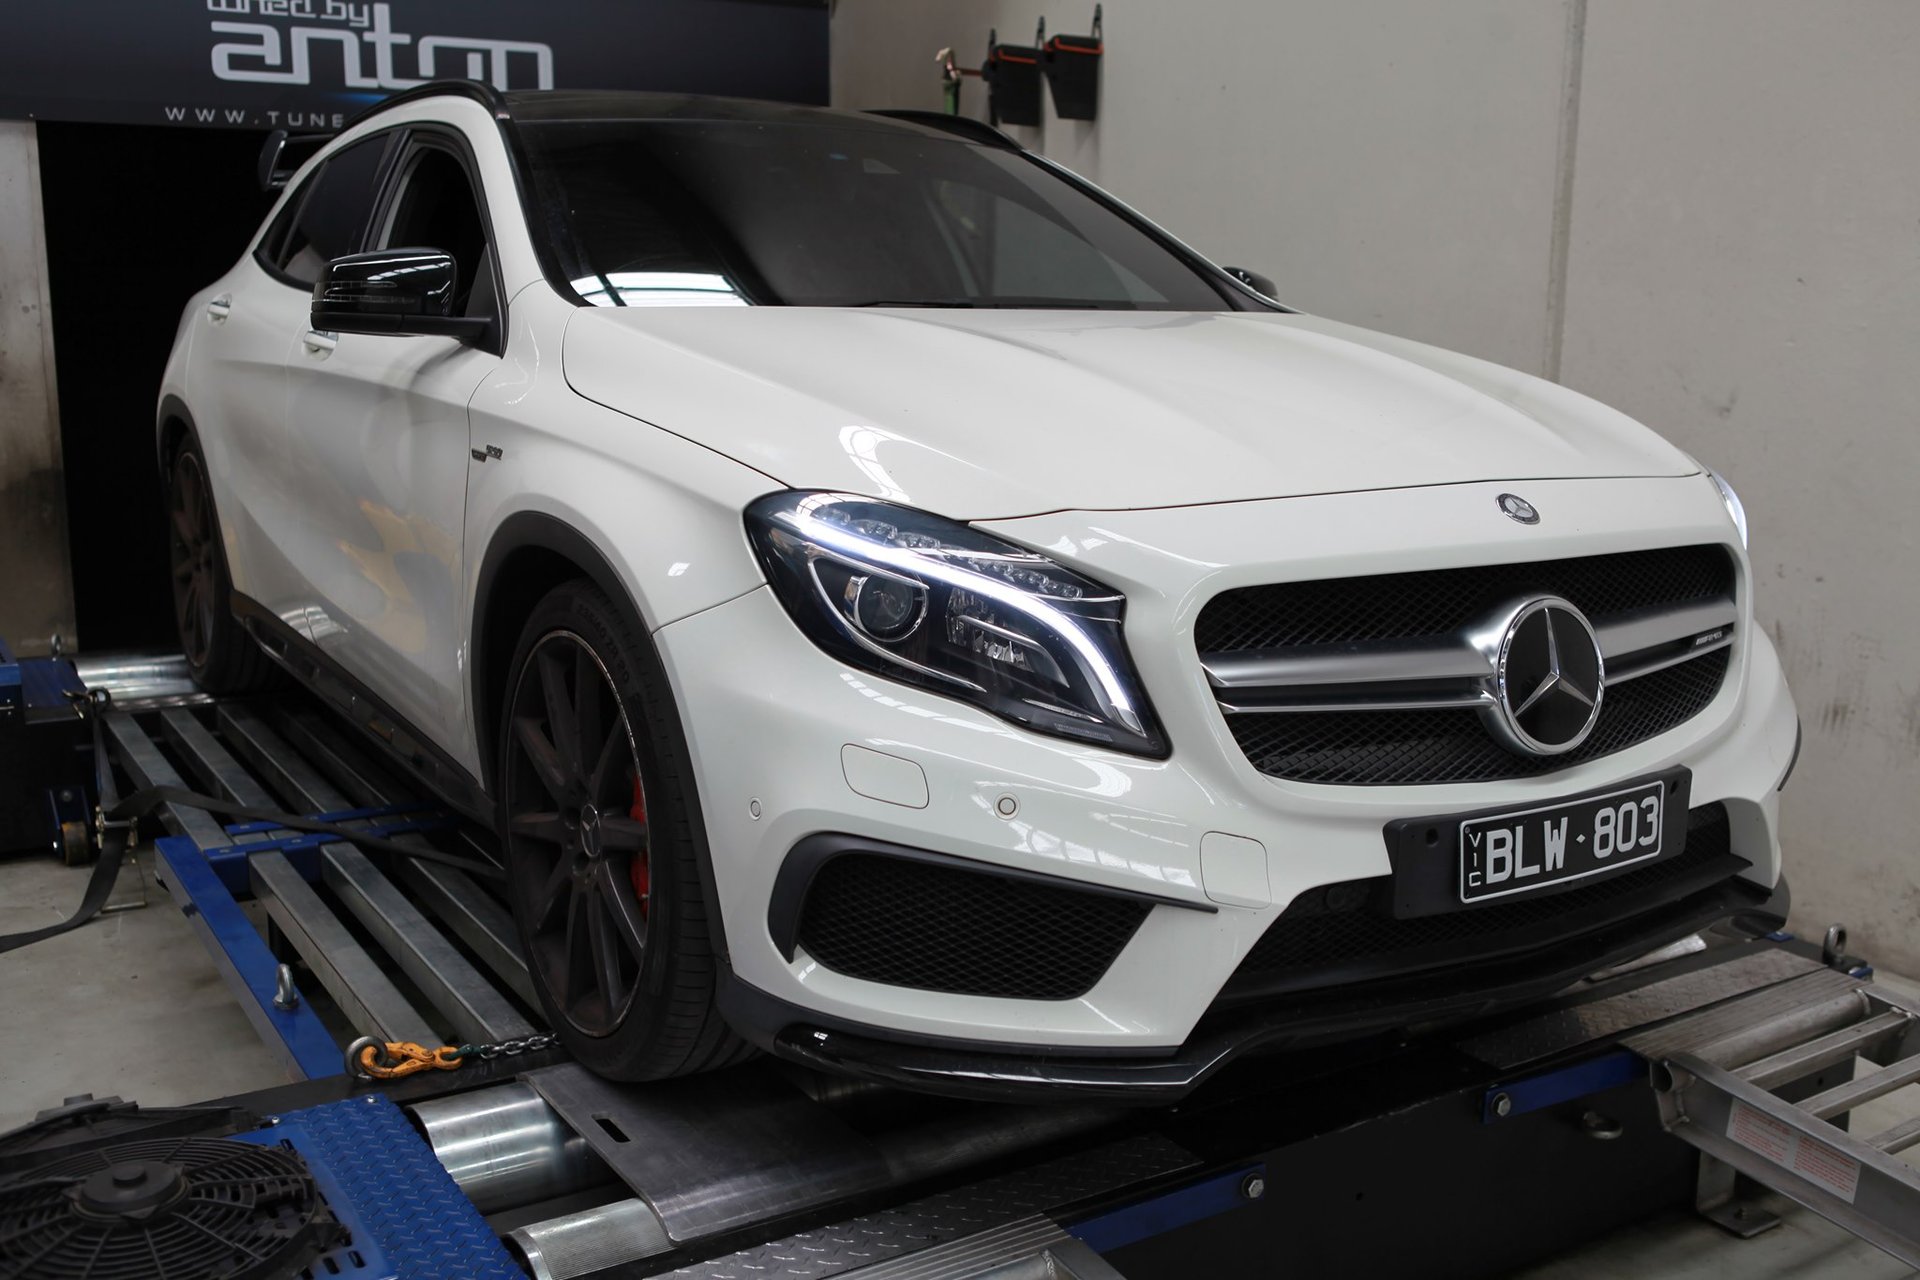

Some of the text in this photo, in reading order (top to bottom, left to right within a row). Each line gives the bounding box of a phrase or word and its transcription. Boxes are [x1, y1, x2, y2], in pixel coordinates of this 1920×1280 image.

[211, 3, 554, 92] anton
[320, 0, 370, 27] by
[1468, 832, 1482, 887] VIC
[1486, 795, 1659, 885] BLW 803
